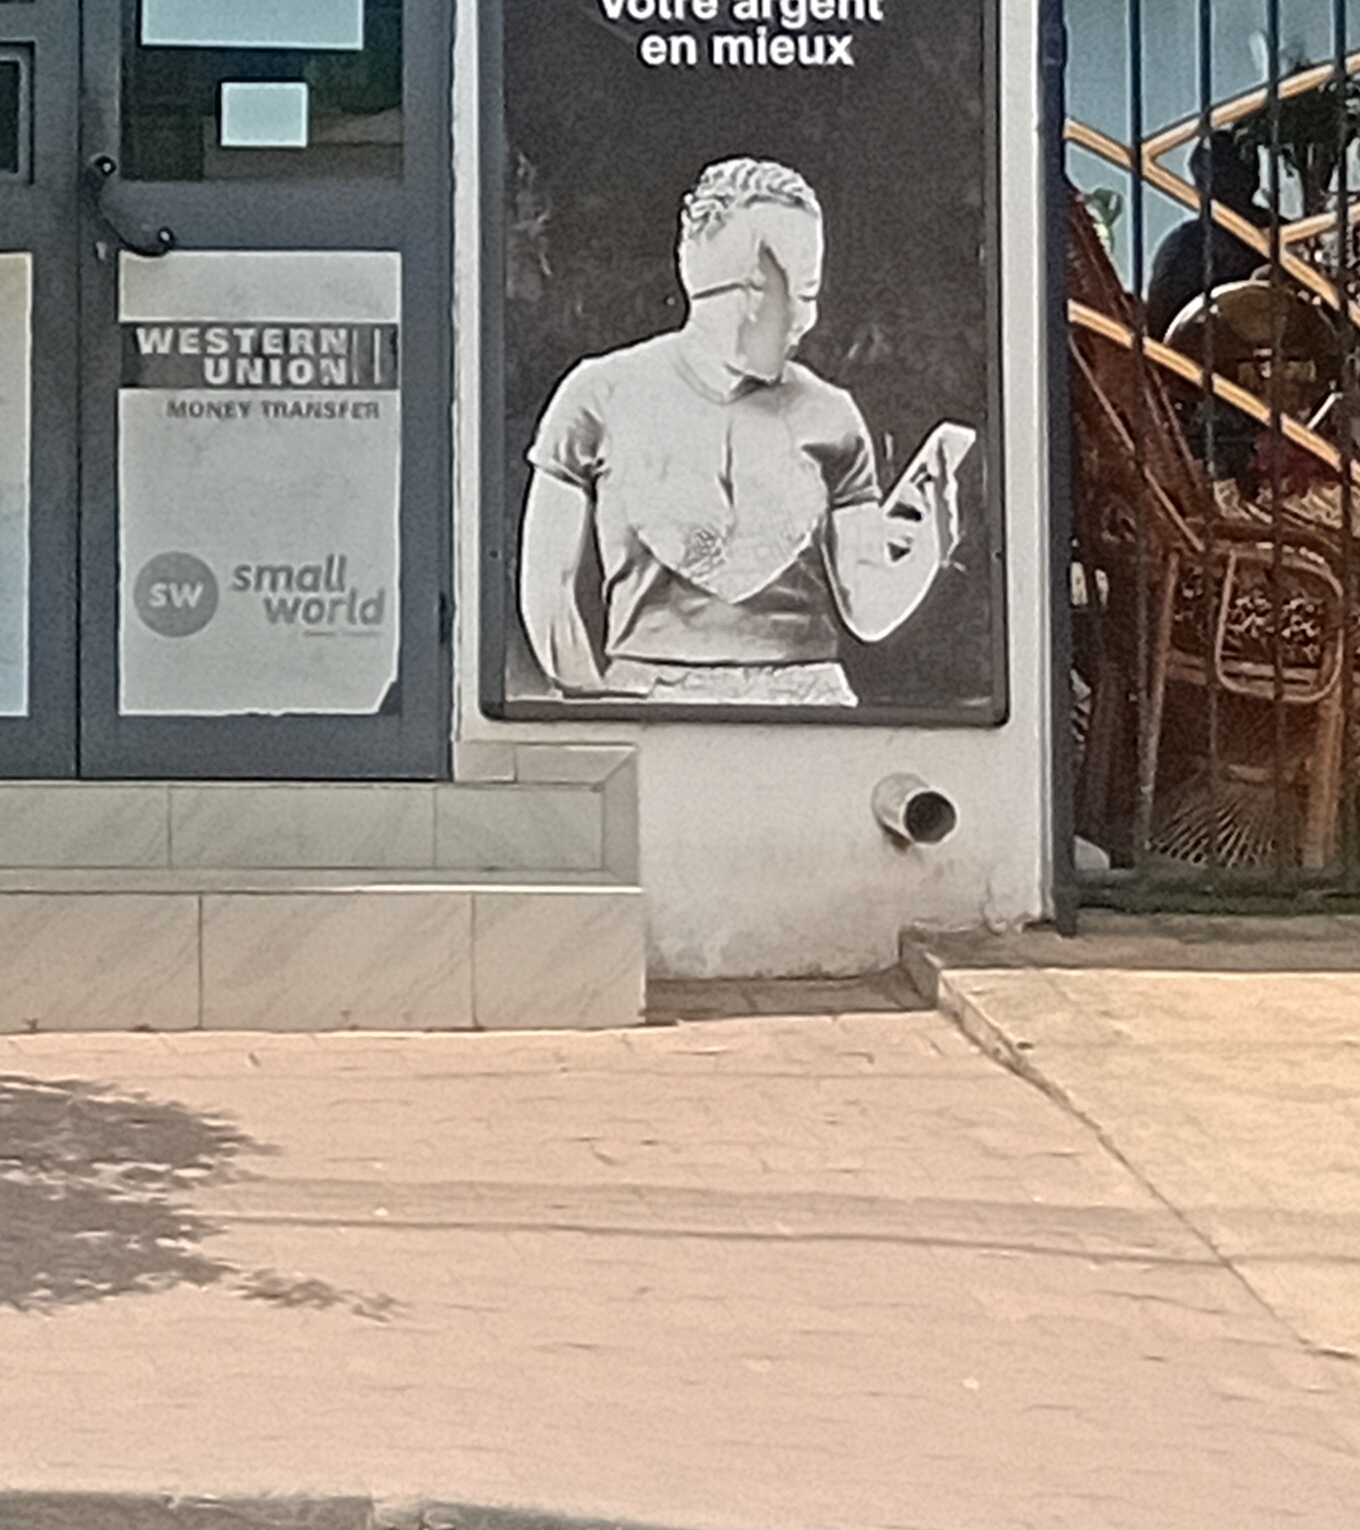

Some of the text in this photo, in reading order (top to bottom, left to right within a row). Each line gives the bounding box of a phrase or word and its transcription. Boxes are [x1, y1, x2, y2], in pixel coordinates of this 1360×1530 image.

[640, 25, 855, 67] en mieux
[135, 327, 348, 355] WESTERN
[203, 357, 347, 386] UNION
[166, 400, 381, 420] MONEY TRANSFER
[232, 552, 348, 594] small
[262, 585, 386, 626] world
